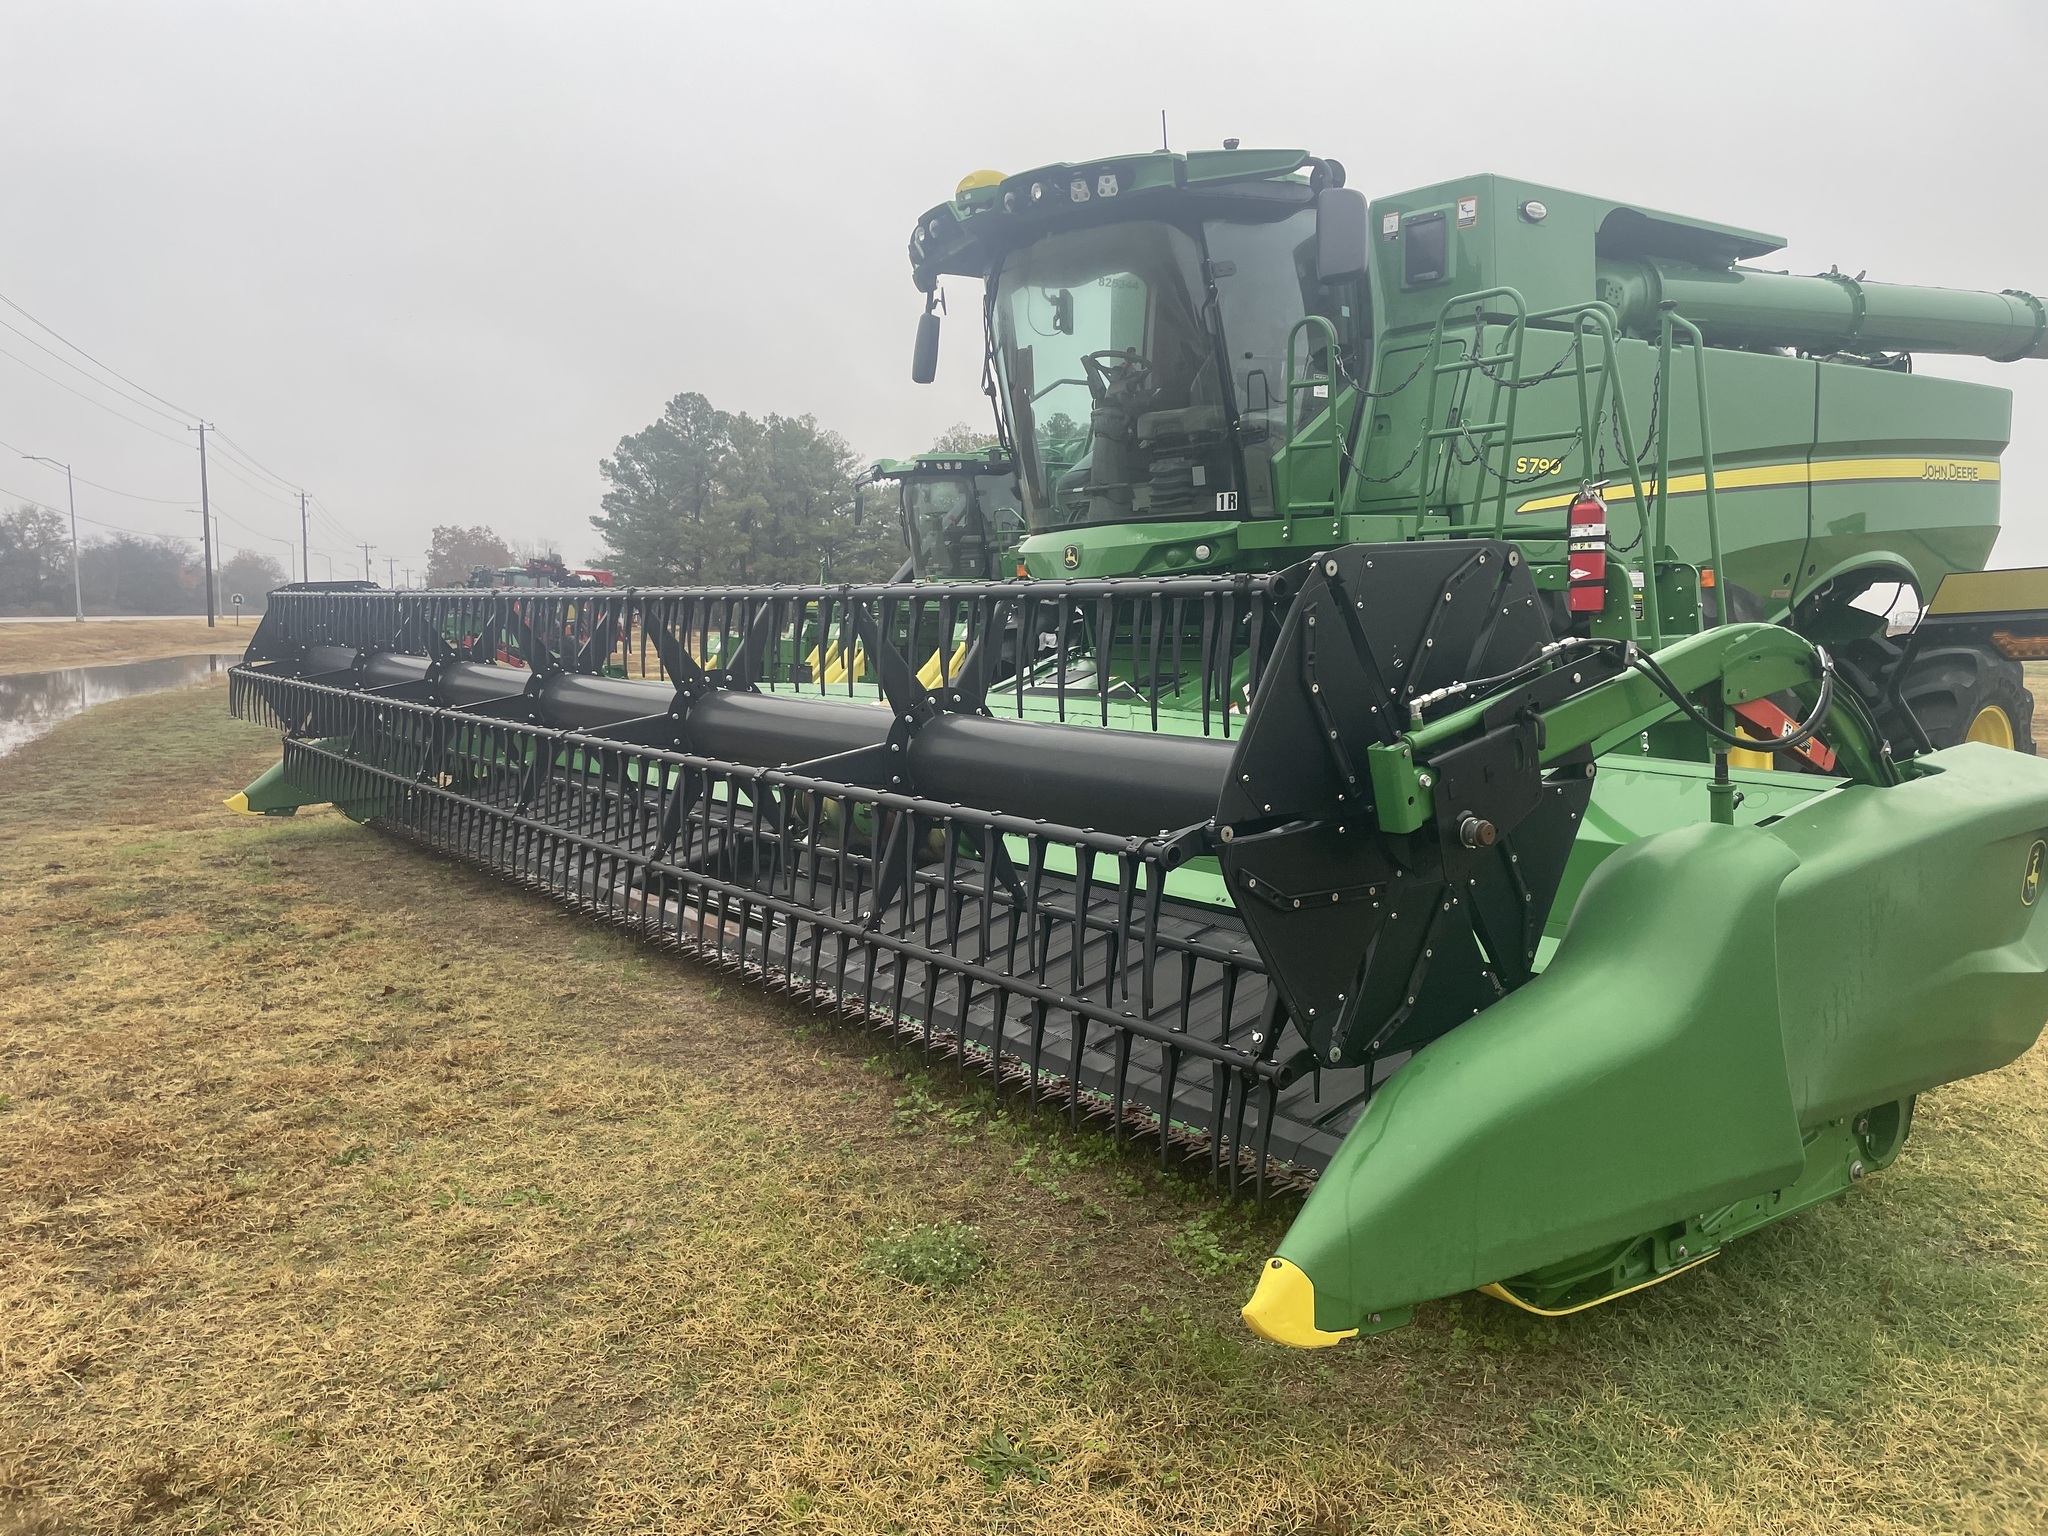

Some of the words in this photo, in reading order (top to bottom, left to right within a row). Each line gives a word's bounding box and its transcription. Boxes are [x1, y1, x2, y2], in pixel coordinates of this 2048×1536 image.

[1516, 457, 1562, 475] S790
[1922, 462, 1947, 478] JOHN
[1949, 463, 1978, 479] DEERE
[1219, 493, 1237, 510] 1R
